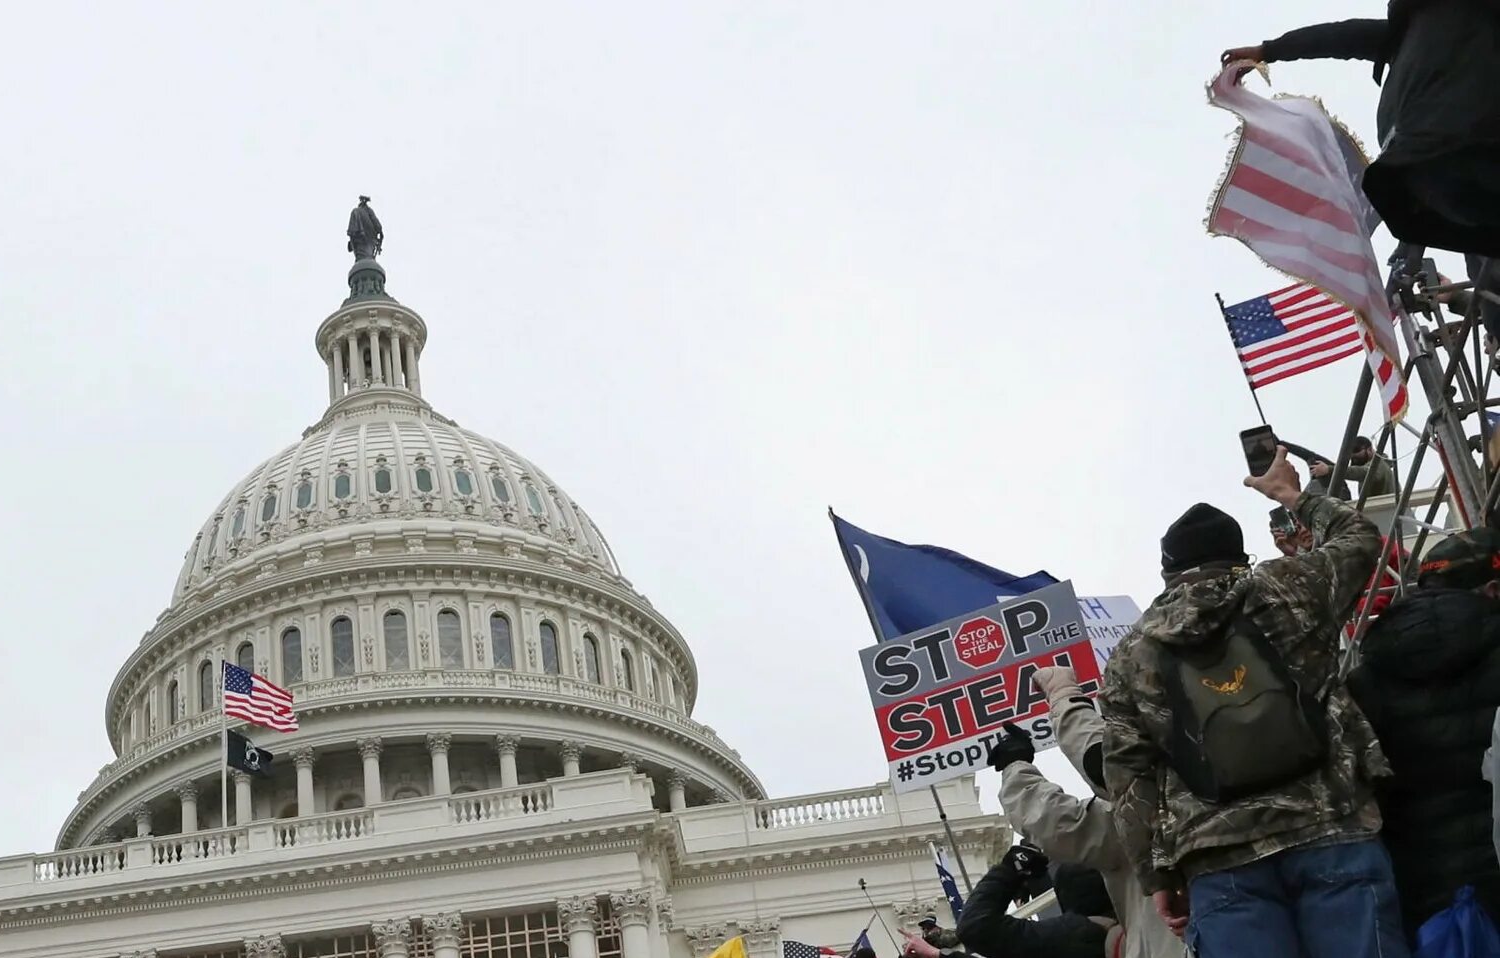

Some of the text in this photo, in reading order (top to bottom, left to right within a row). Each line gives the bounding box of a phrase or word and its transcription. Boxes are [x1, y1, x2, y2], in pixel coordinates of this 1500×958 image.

[959, 624, 996, 645] STOP
[970, 636, 989, 647] THE
[1040, 622, 1080, 647] THE
[961, 640, 1002, 659] STEAL
